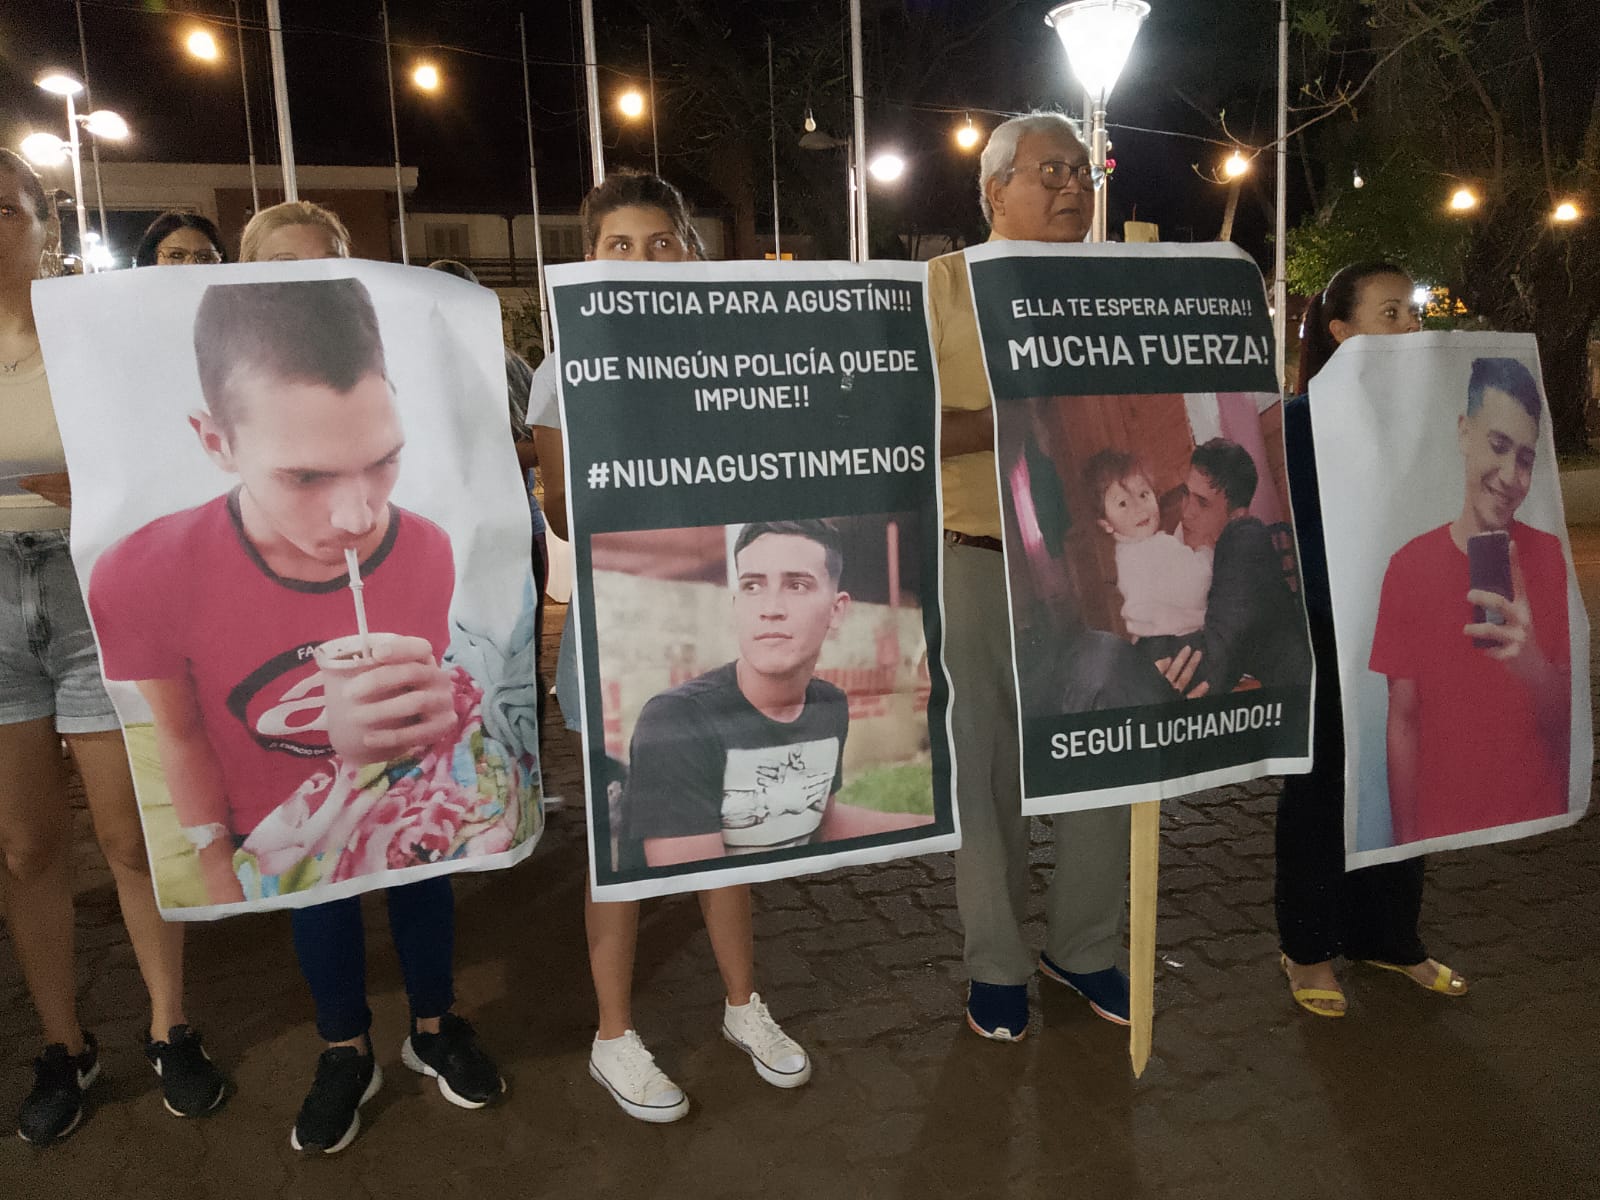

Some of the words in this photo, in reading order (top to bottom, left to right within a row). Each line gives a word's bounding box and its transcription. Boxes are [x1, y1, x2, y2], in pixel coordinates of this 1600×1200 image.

[579, 290, 704, 317] JUSTICIA
[708, 289, 780, 316] PARA
[784, 283, 913, 314] AGUSTÍN!!!
[1011, 298, 1066, 320] ELLA
[1066, 298, 1093, 317] TE
[1095, 298, 1171, 317] ESPERA
[1173, 298, 1253, 317] AFUERA!!
[564, 357, 622, 386] QUE
[627, 350, 729, 380] NINGÚN
[735, 347, 835, 376] POLICÍA
[839, 349, 920, 376] QUEDE
[1007, 335, 1136, 371] MUCHA
[1139, 334, 1270, 366] FUERZA!
[694, 385, 811, 412] IMPUNE!!
[587, 446, 925, 489] #NIUNAGUSTINMENOS
[1051, 718, 1133, 760] SEGUÍ
[1140, 703, 1282, 749] LUCHANDO!!
